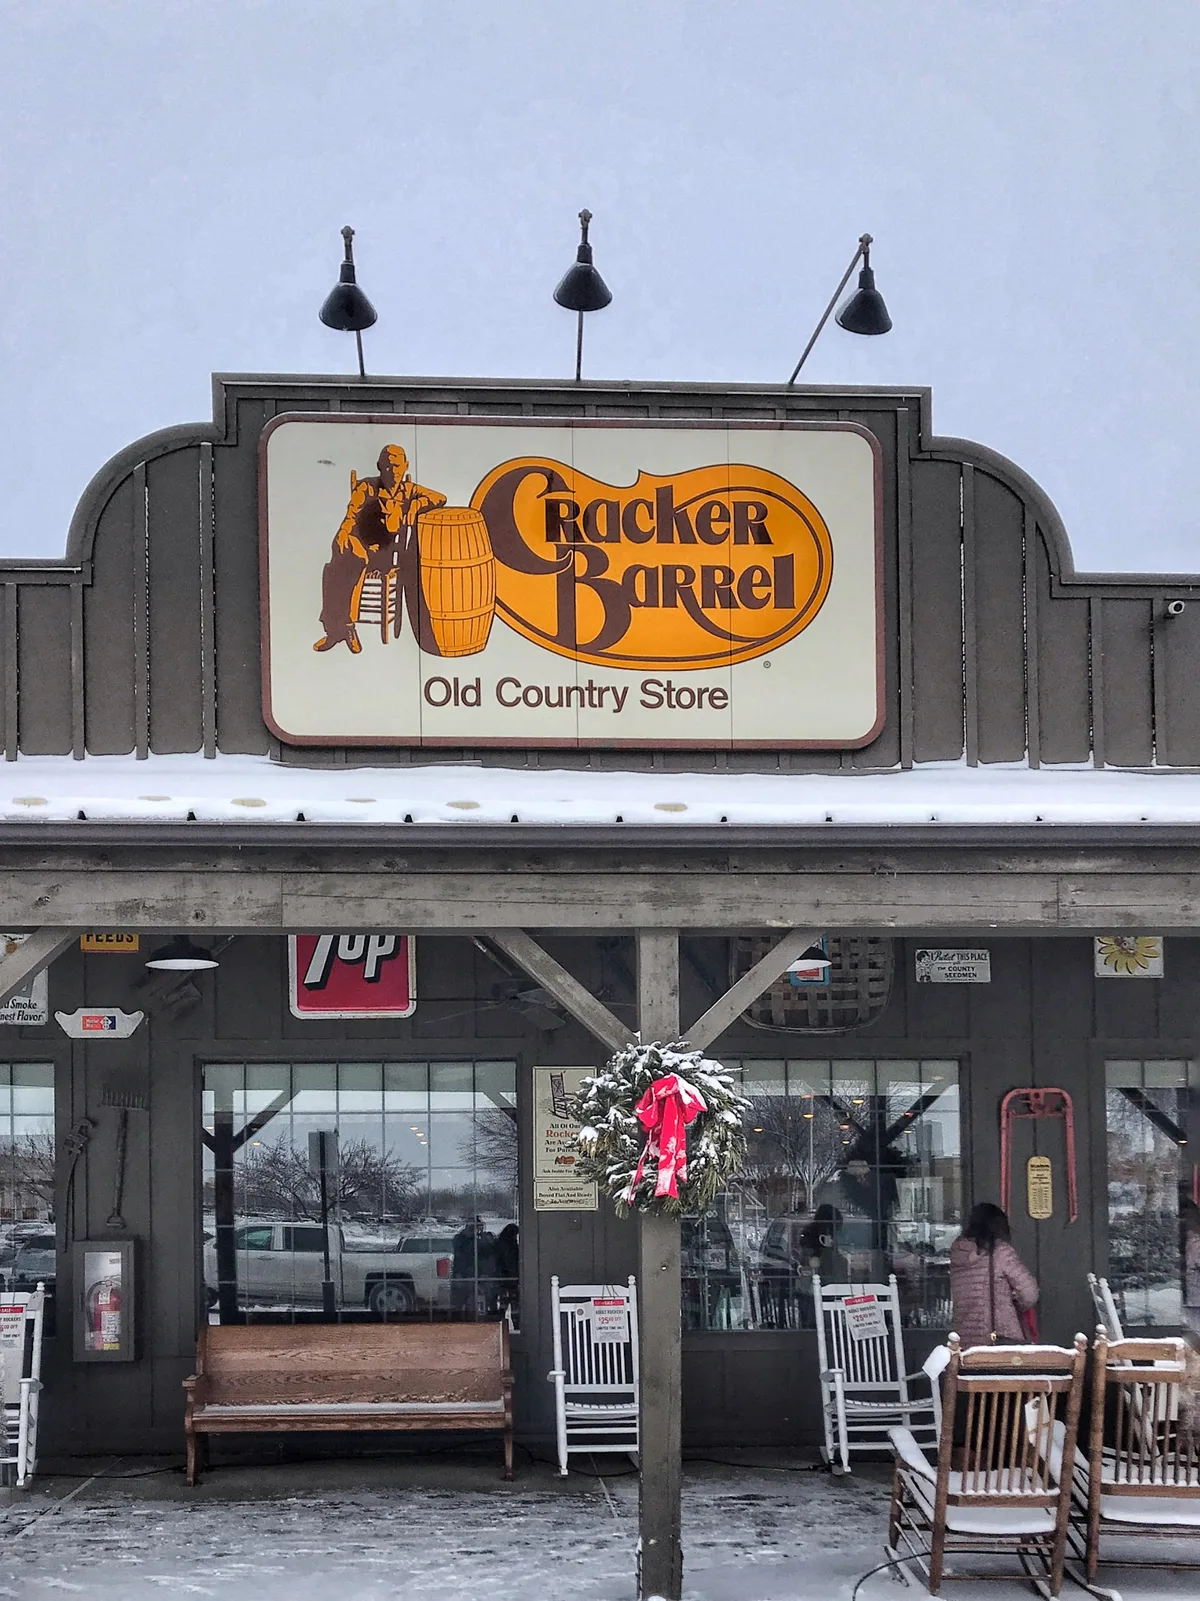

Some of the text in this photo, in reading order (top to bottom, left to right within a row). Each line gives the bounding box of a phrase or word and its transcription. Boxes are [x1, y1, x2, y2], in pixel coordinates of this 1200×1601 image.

[480, 466, 773, 575] Cracker
[555, 543, 797, 650] Barrel
[424, 676, 729, 713] Old Country Store
[957, 953, 970, 961] THIS
[970, 953, 988, 961] PLACE
[10, 998, 38, 1009] Smoke
[0, 1012, 16, 1021] nest
